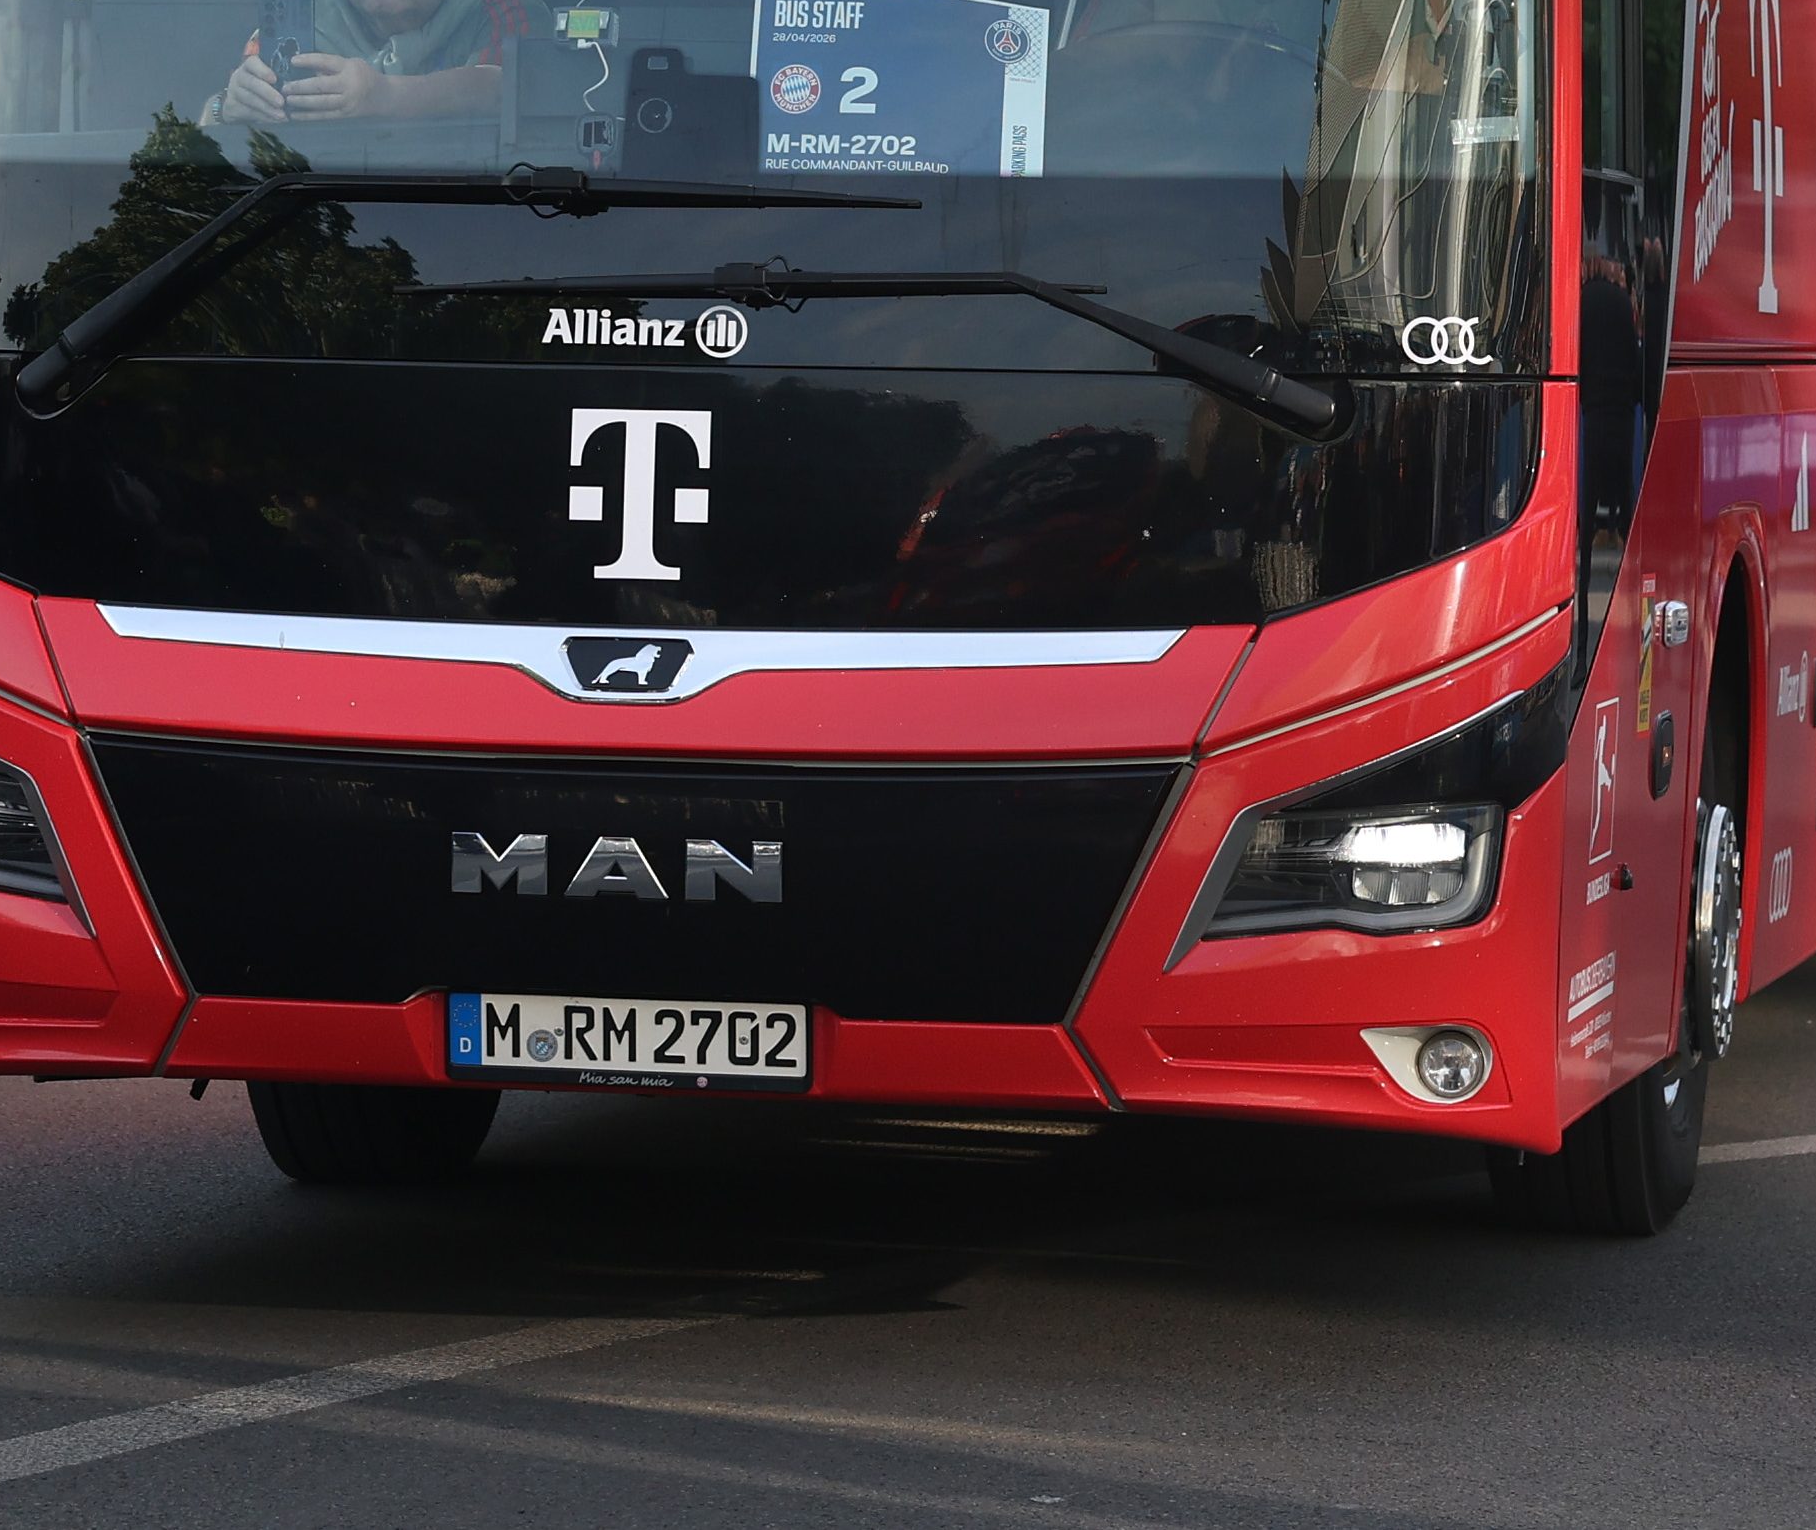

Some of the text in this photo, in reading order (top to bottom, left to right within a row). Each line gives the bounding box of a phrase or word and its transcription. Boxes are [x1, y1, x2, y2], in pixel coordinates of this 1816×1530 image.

[774, 0, 865, 30] BUS STAFF
[772, 32, 837, 44] 28/04/2026
[992, 22, 1022, 35] PARIS
[839, 66, 879, 114] 2
[767, 133, 916, 156] M-RM-2702
[1012, 125, 1028, 146] PASS
[765, 158, 949, 175] RUE COMMANDANT-GUILBAUD
[542, 307, 686, 347] Allianz
[568, 408, 712, 580] T
[450, 830, 784, 904] MAN
[459, 1037, 472, 1053] D
[486, 1002, 798, 1068] M RM 2702
[579, 1071, 674, 1087] Mia san mia
